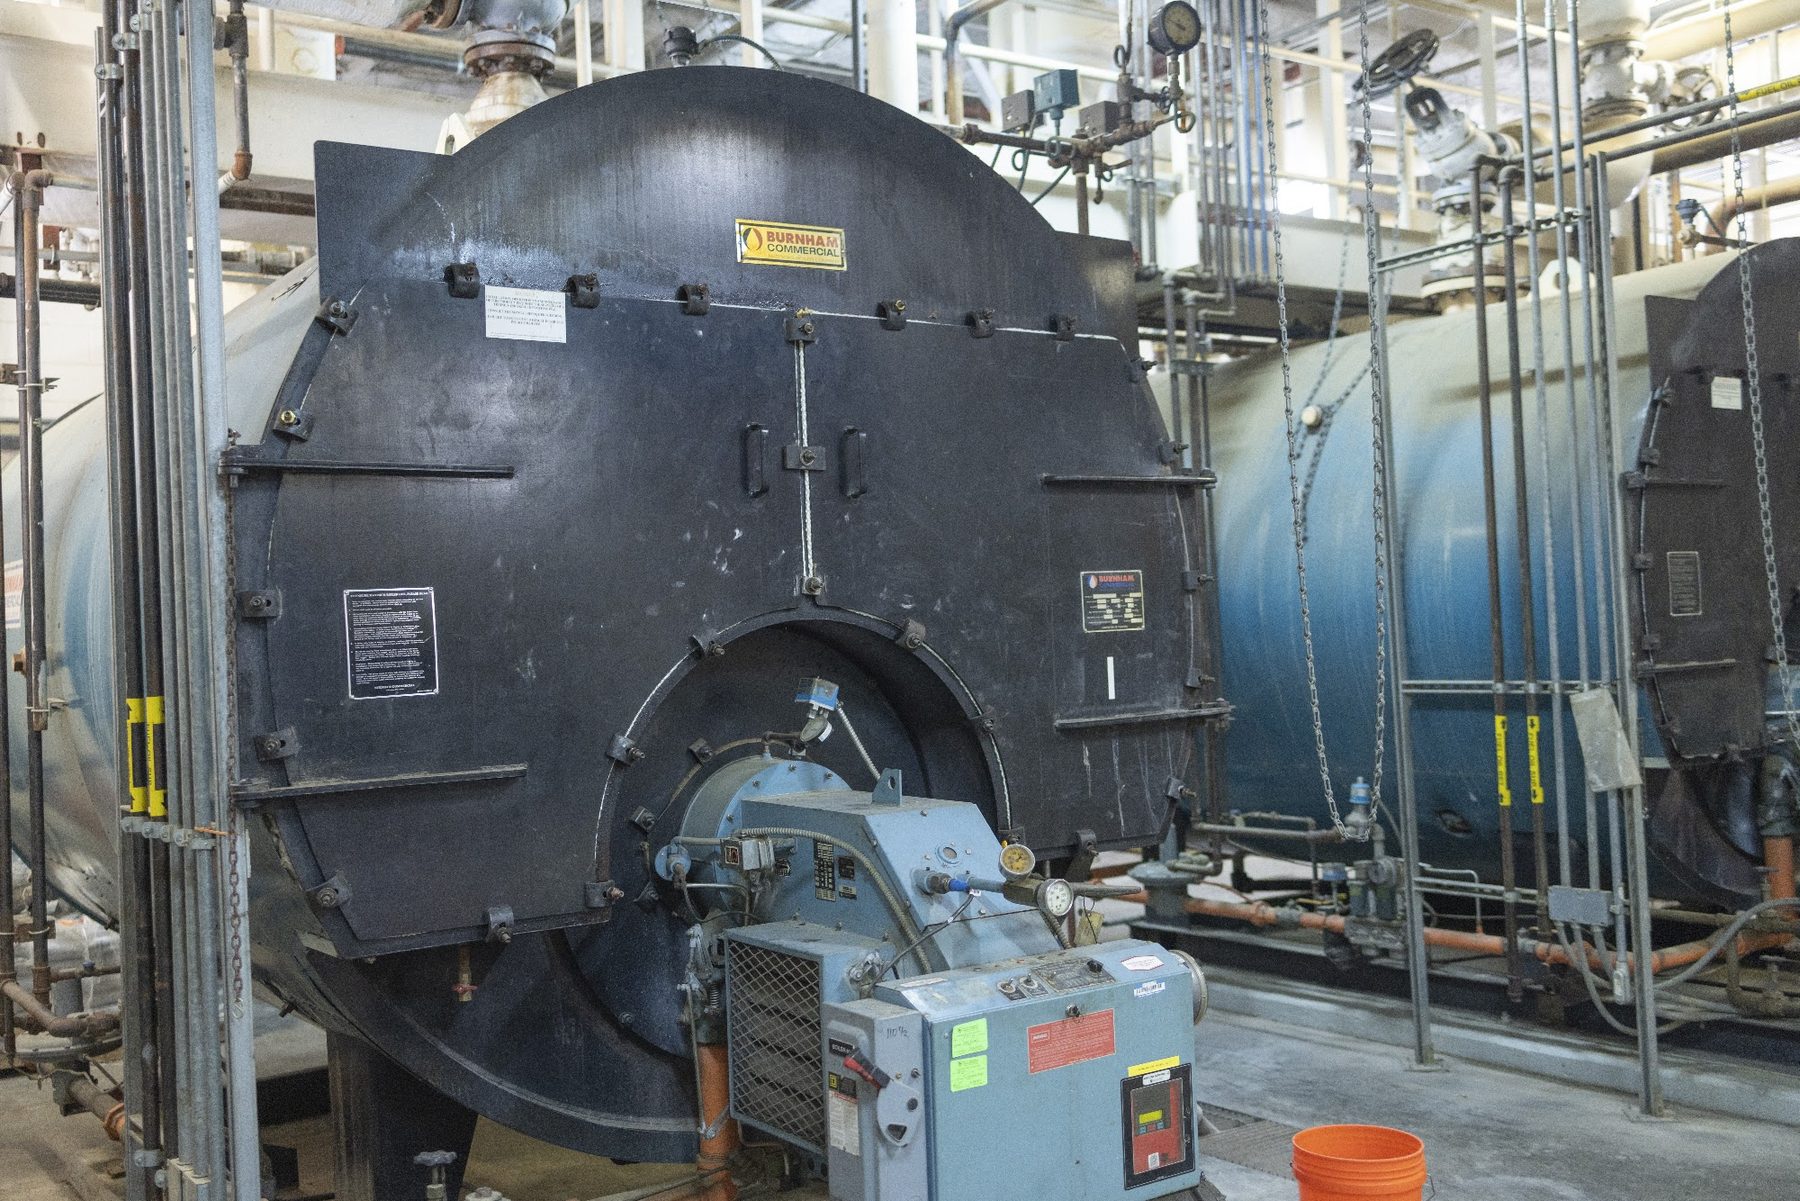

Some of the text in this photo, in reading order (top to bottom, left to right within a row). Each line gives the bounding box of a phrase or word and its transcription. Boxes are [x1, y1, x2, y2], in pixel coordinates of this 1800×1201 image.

[1756, 79, 1792, 97] FUEL OIL
[766, 230, 839, 248] BURNHAM
[767, 243, 840, 257] COMMERCIAL
